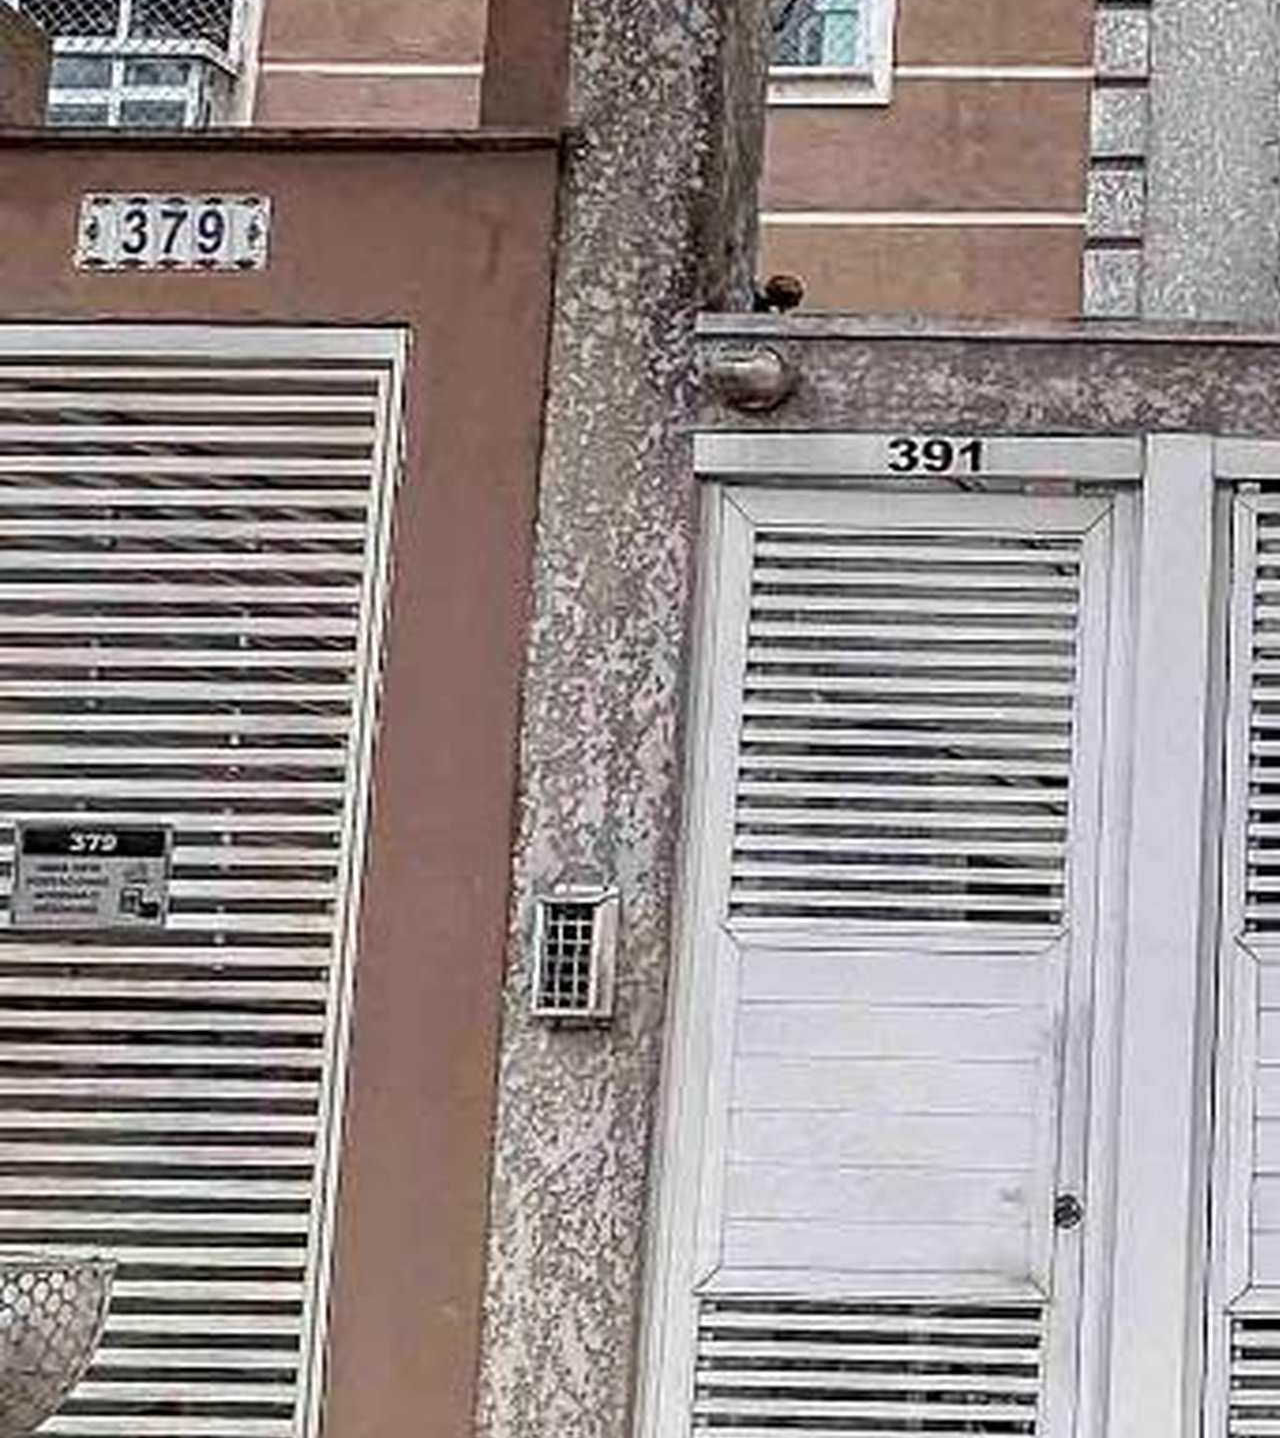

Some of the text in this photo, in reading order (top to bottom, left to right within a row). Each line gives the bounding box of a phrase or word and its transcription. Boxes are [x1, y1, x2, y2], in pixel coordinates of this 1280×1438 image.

[121, 208, 225, 255] 379
[887, 438, 982, 473] 391
[68, 832, 119, 852] 379
